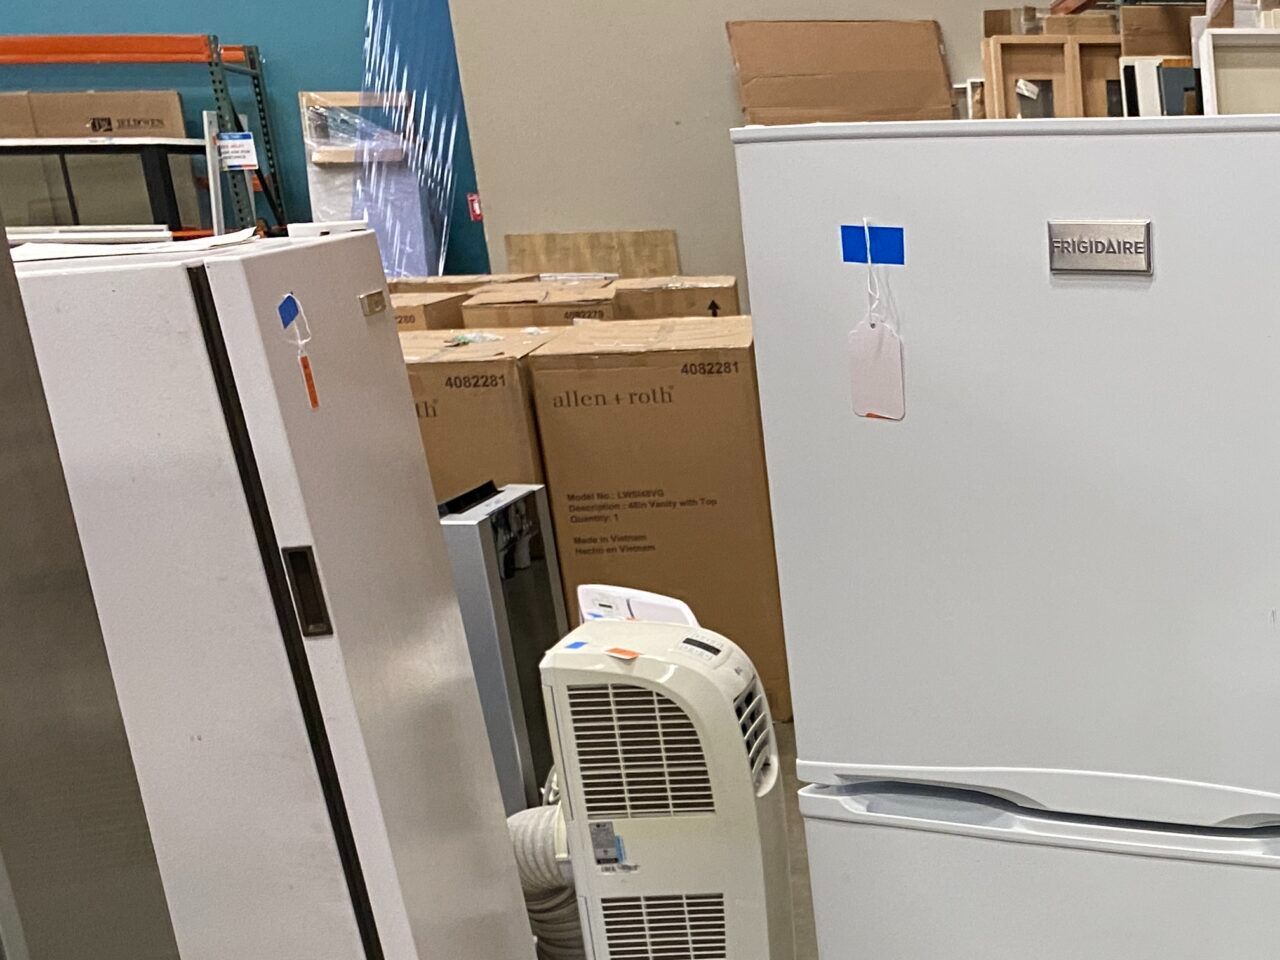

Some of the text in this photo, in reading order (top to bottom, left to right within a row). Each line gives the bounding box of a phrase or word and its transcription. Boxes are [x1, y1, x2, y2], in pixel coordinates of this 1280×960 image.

[1052, 239, 1146, 254] FRIGIDAIRE
[681, 361, 740, 375] 4082281
[445, 374, 506, 388] 4082281
[553, 389, 607, 408] allen
[628, 386, 674, 405] roth
[569, 503, 620, 512] Description
[649, 500, 678, 509] Vanity
[700, 497, 718, 506] Top
[611, 534, 647, 542] Vietnam
[619, 544, 656, 552] Vietnam
